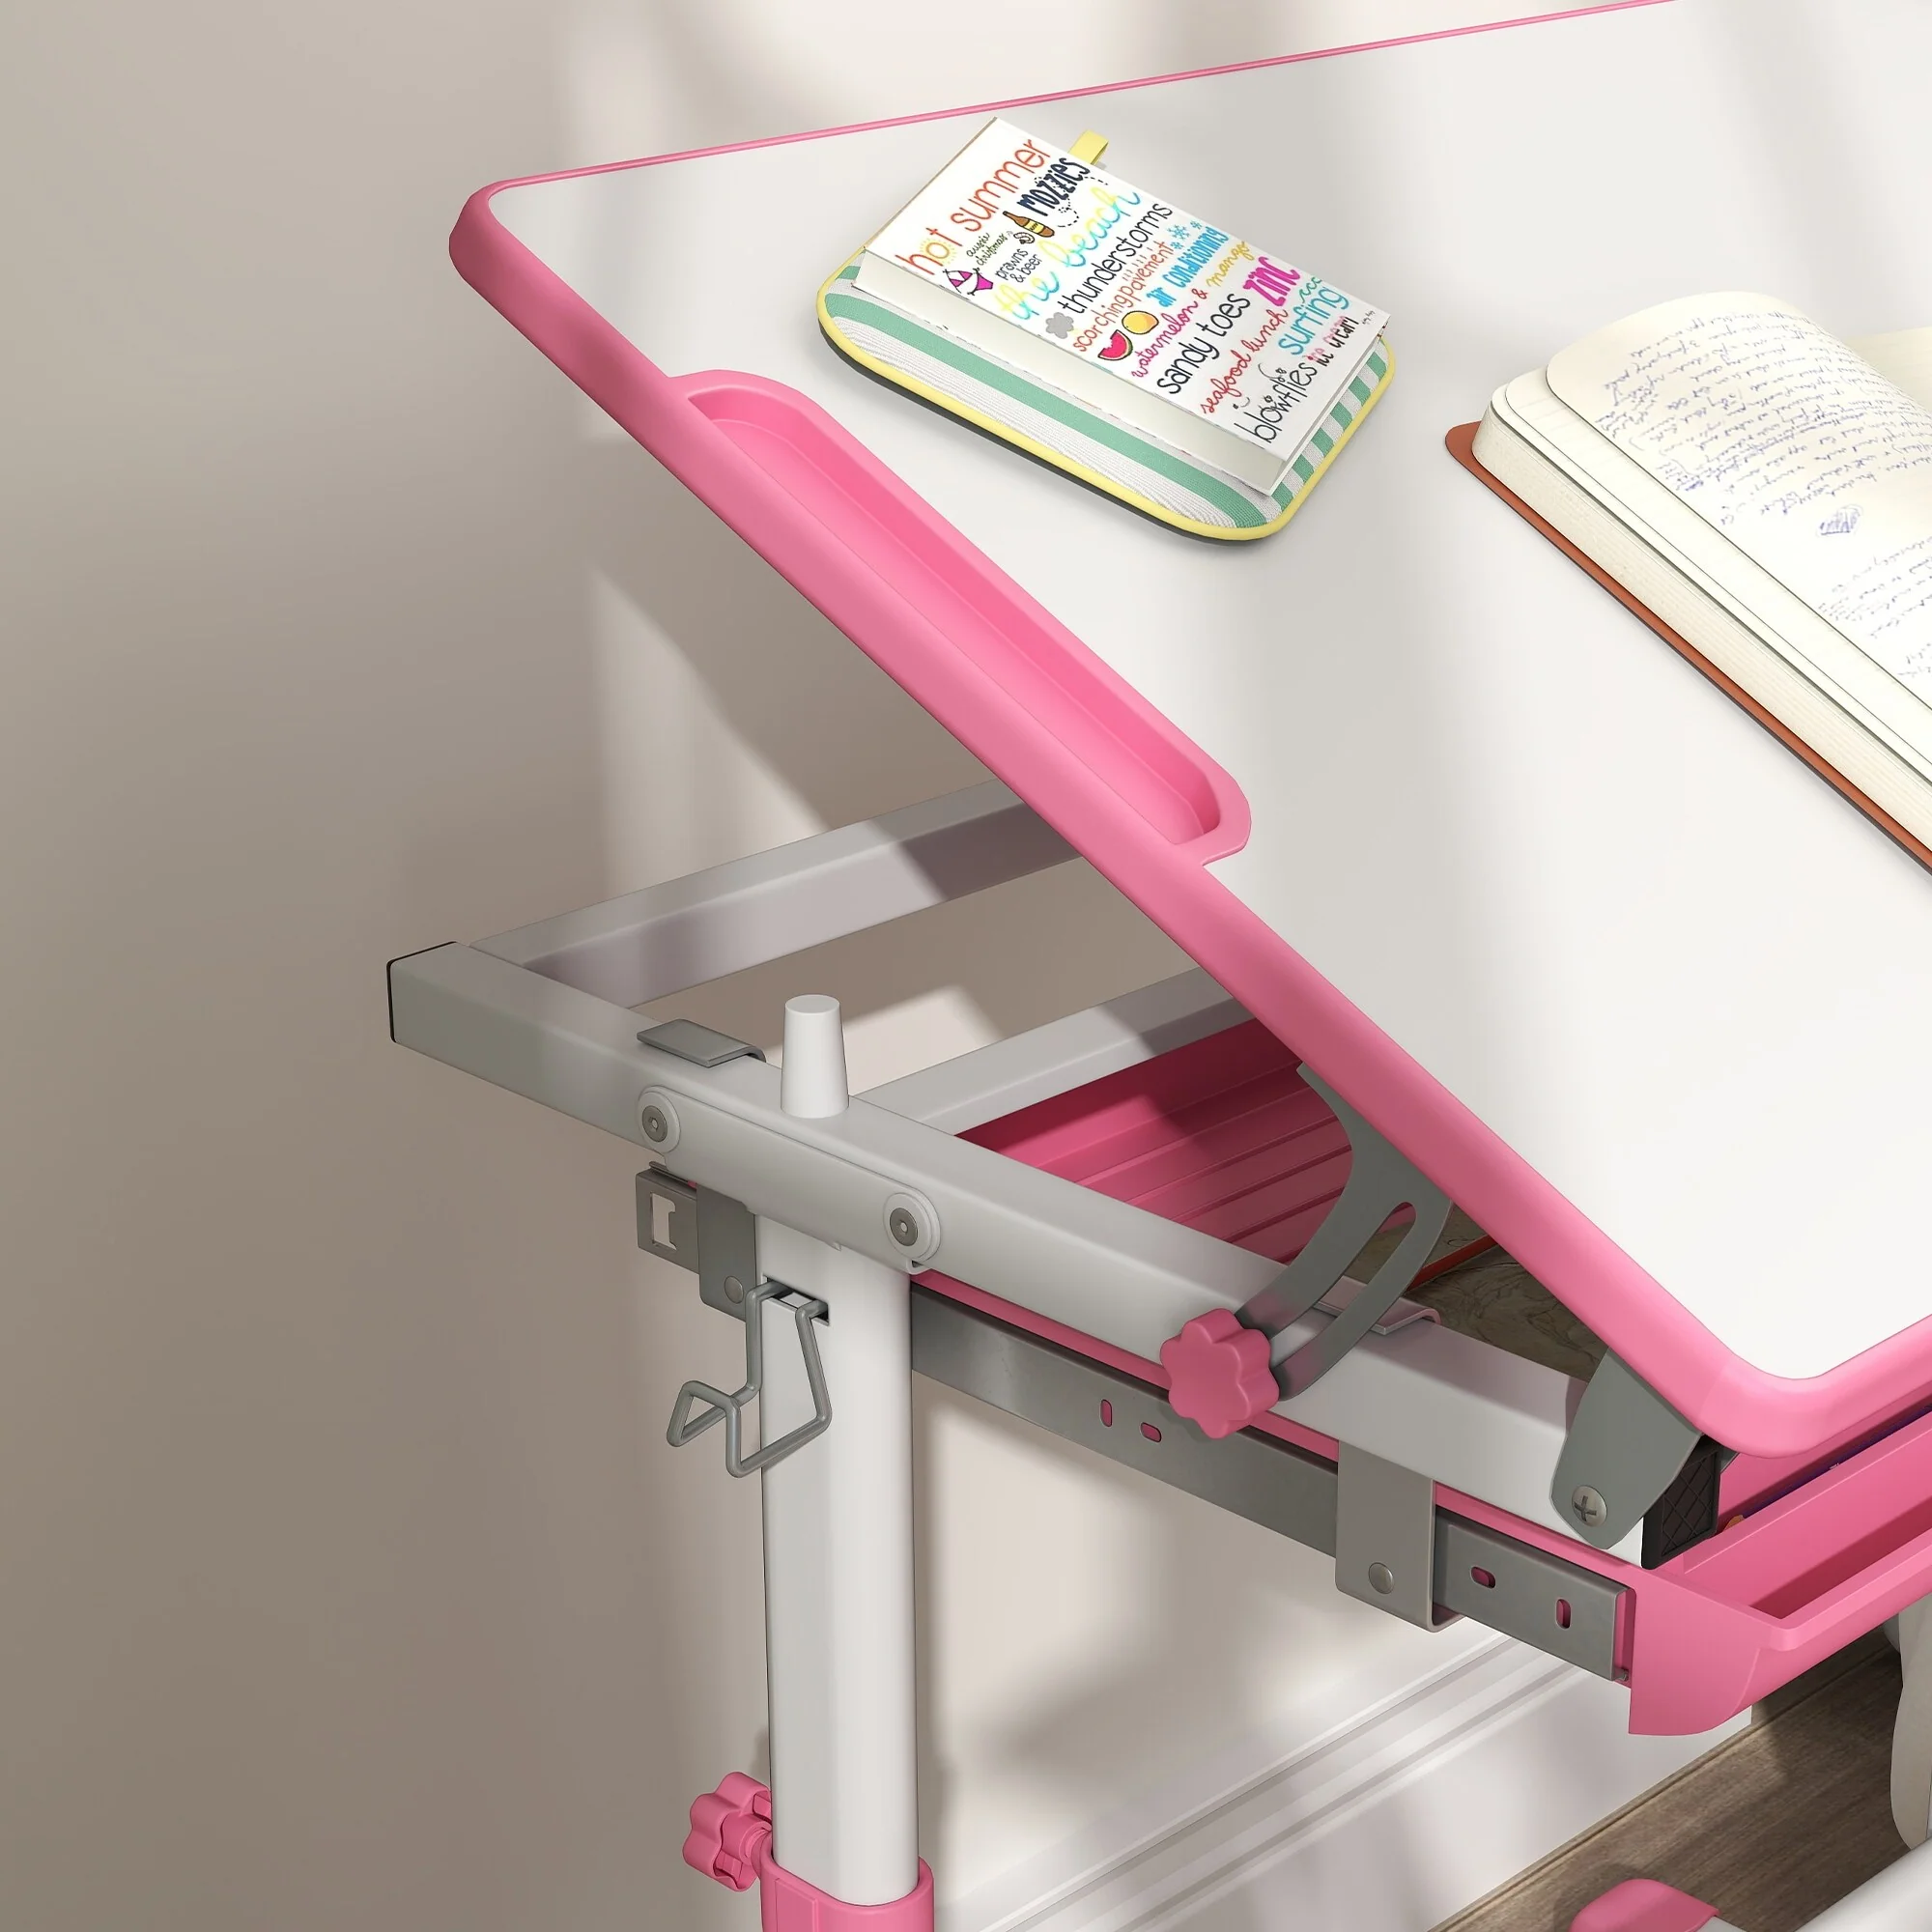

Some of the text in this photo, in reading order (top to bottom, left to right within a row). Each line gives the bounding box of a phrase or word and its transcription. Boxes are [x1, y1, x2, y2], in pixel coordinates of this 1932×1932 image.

[895, 139, 1051, 275] hot summer
[993, 186, 1142, 320] the beach
[995, 248, 1029, 281] prawns
[1009, 273, 1026, 283] &
[1016, 254, 1042, 276] beer
[1057, 203, 1173, 314] thunderstorms
[1162, 226, 1230, 289] conditioning
[1131, 241, 1255, 378] watermelon & mango
[1156, 293, 1251, 394] sandy toes
[1278, 287, 1350, 355] surfing
[1307, 316, 1359, 367] ice cream
[1201, 309, 1289, 415] seafood lunch
[1234, 363, 1318, 443] blowflies
